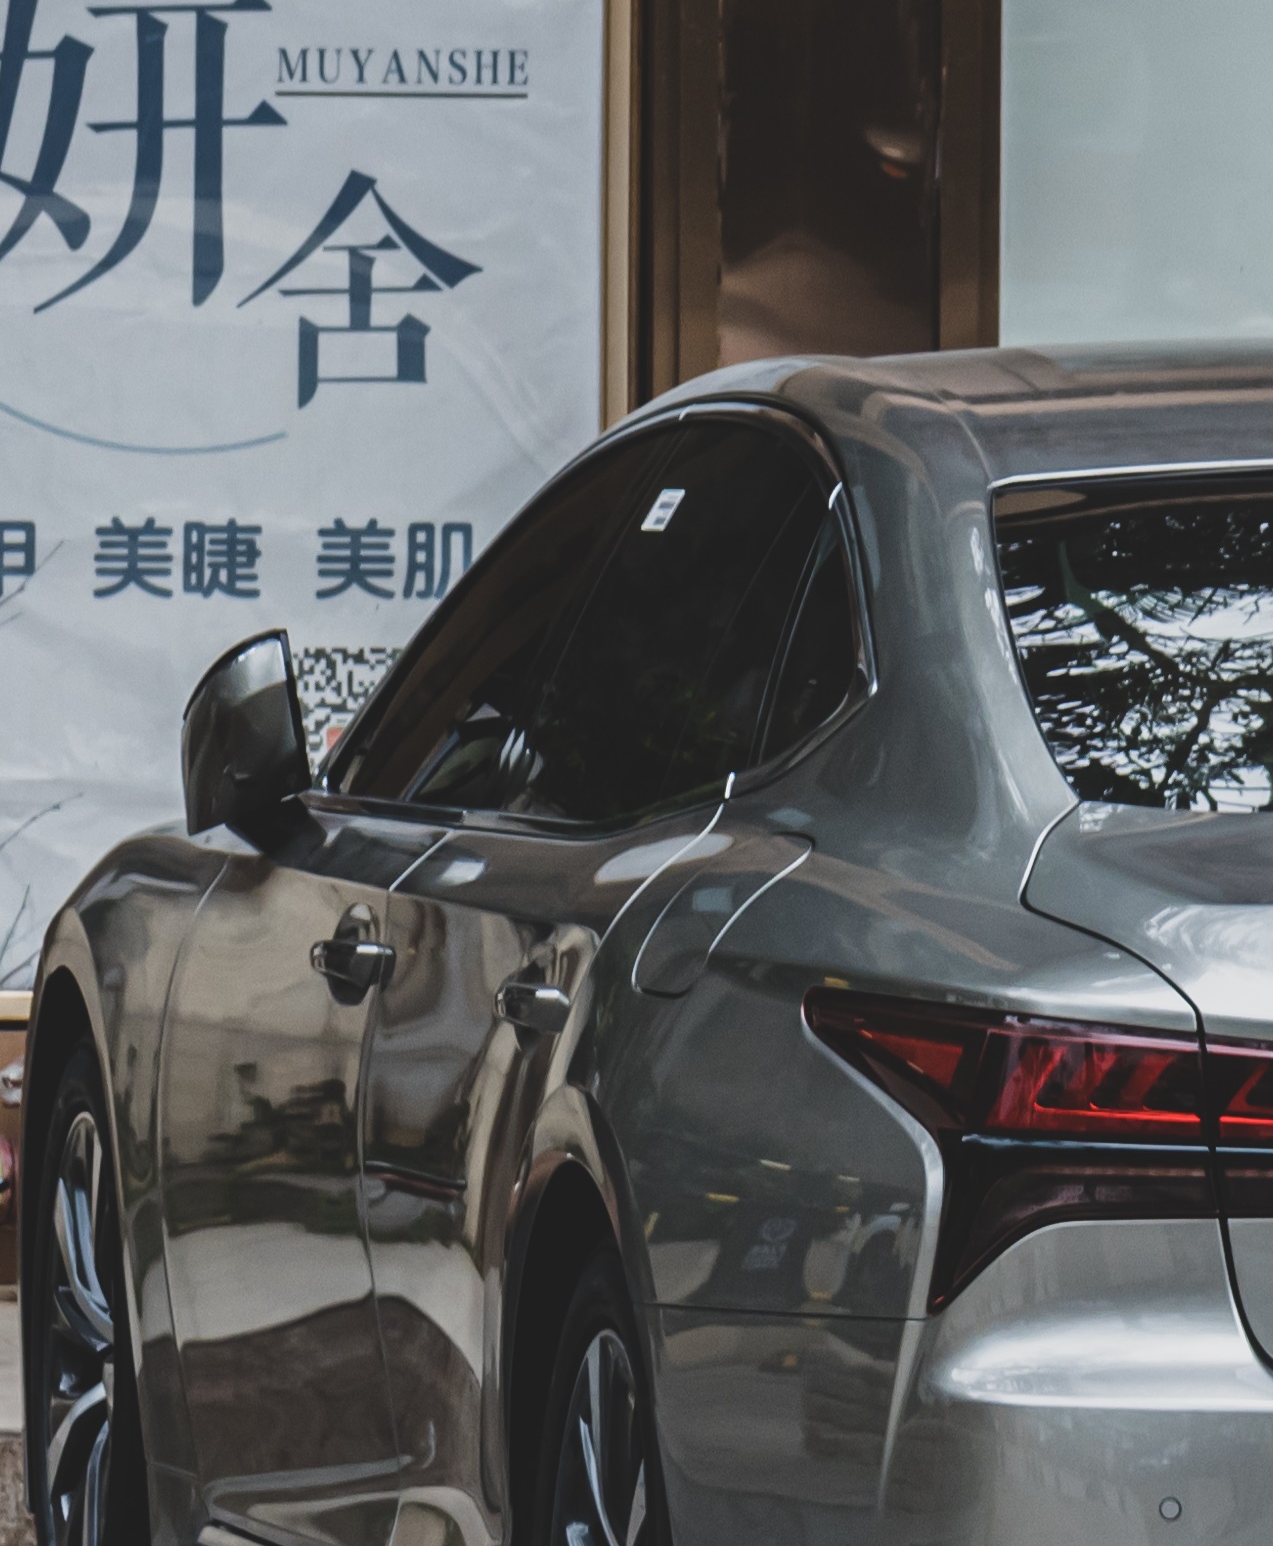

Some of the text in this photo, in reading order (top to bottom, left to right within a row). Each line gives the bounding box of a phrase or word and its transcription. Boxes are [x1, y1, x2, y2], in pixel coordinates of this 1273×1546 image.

[277, 47, 529, 86] MUYANSHE
[93, 516, 263, 599] 美睫
[316, 517, 474, 599] 美肌
